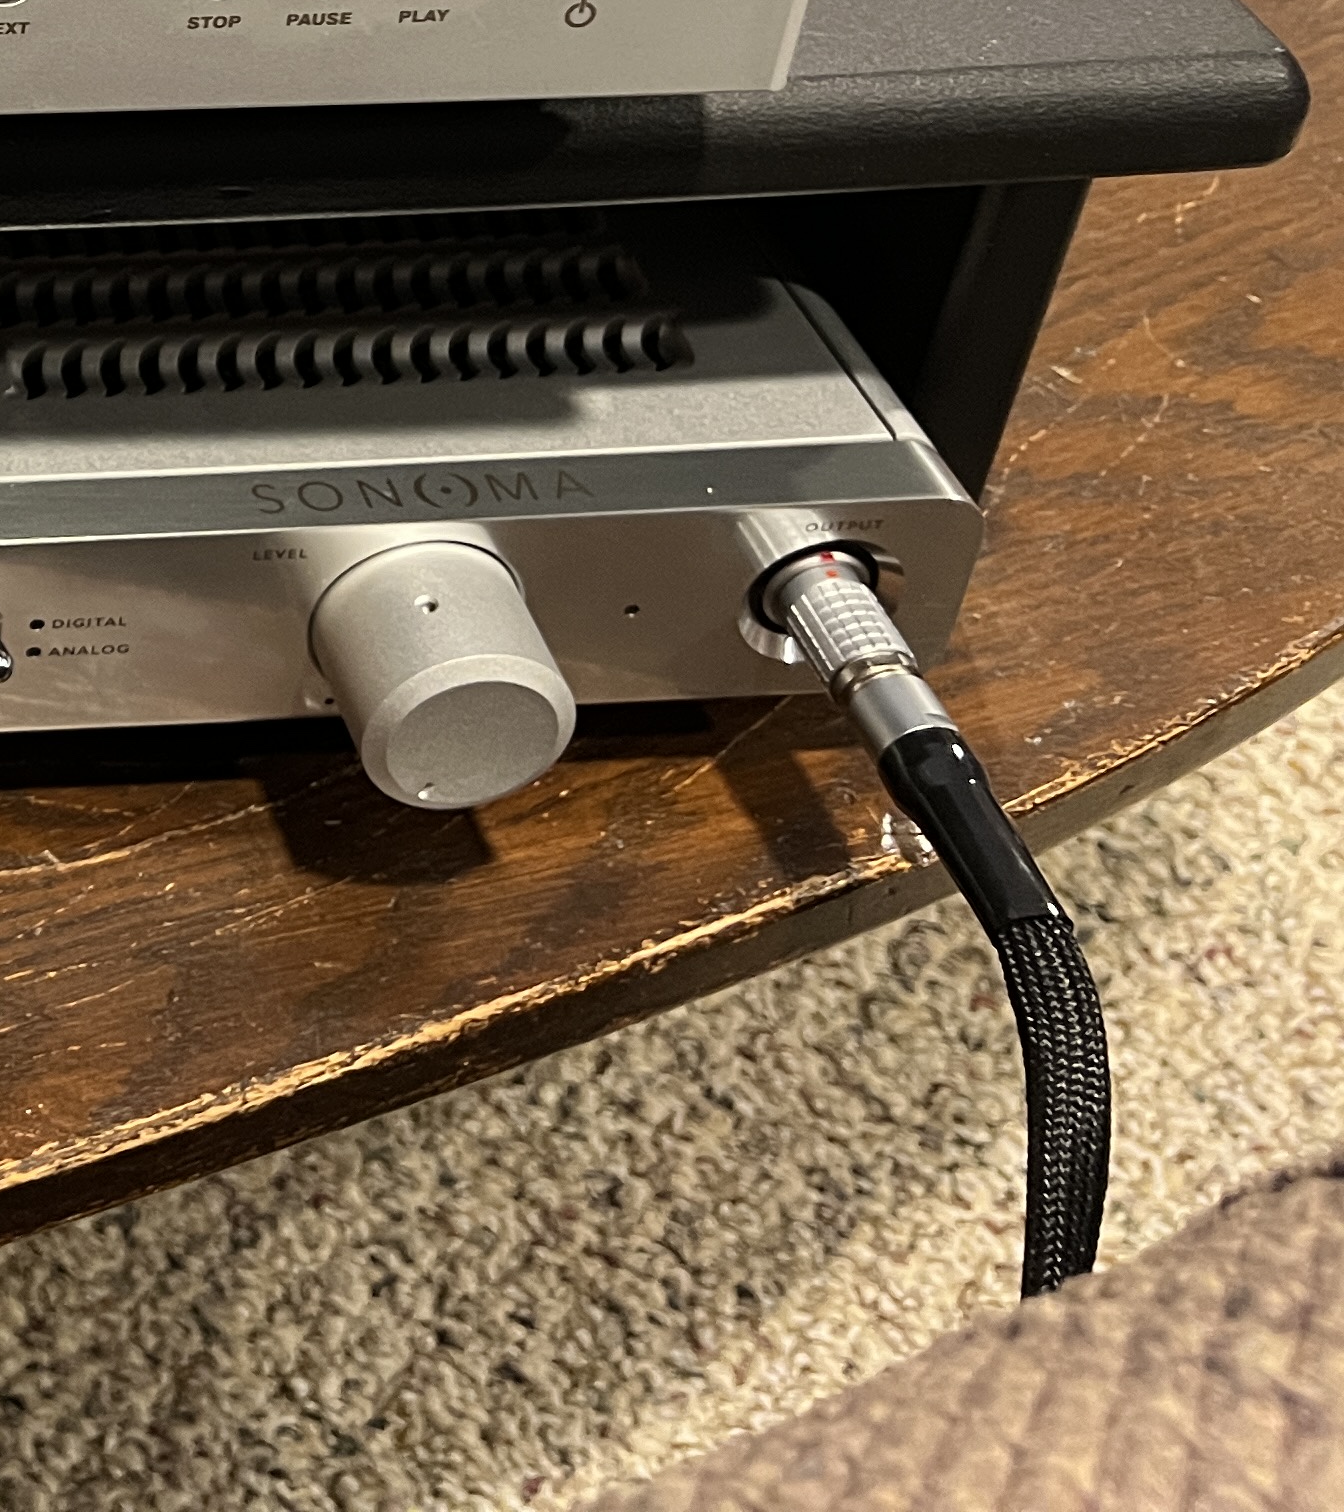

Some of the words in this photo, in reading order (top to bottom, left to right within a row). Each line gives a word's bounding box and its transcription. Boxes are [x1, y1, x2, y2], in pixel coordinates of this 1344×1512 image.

[187, 15, 242, 29] STOP
[285, 11, 353, 27] PAUSE
[398, 9, 450, 23] PLAY
[805, 519, 885, 533] OUTPUT
[252, 548, 308, 562] LEVEL
[52, 616, 127, 629] DIGITAL
[47, 643, 130, 657] ANALOG
